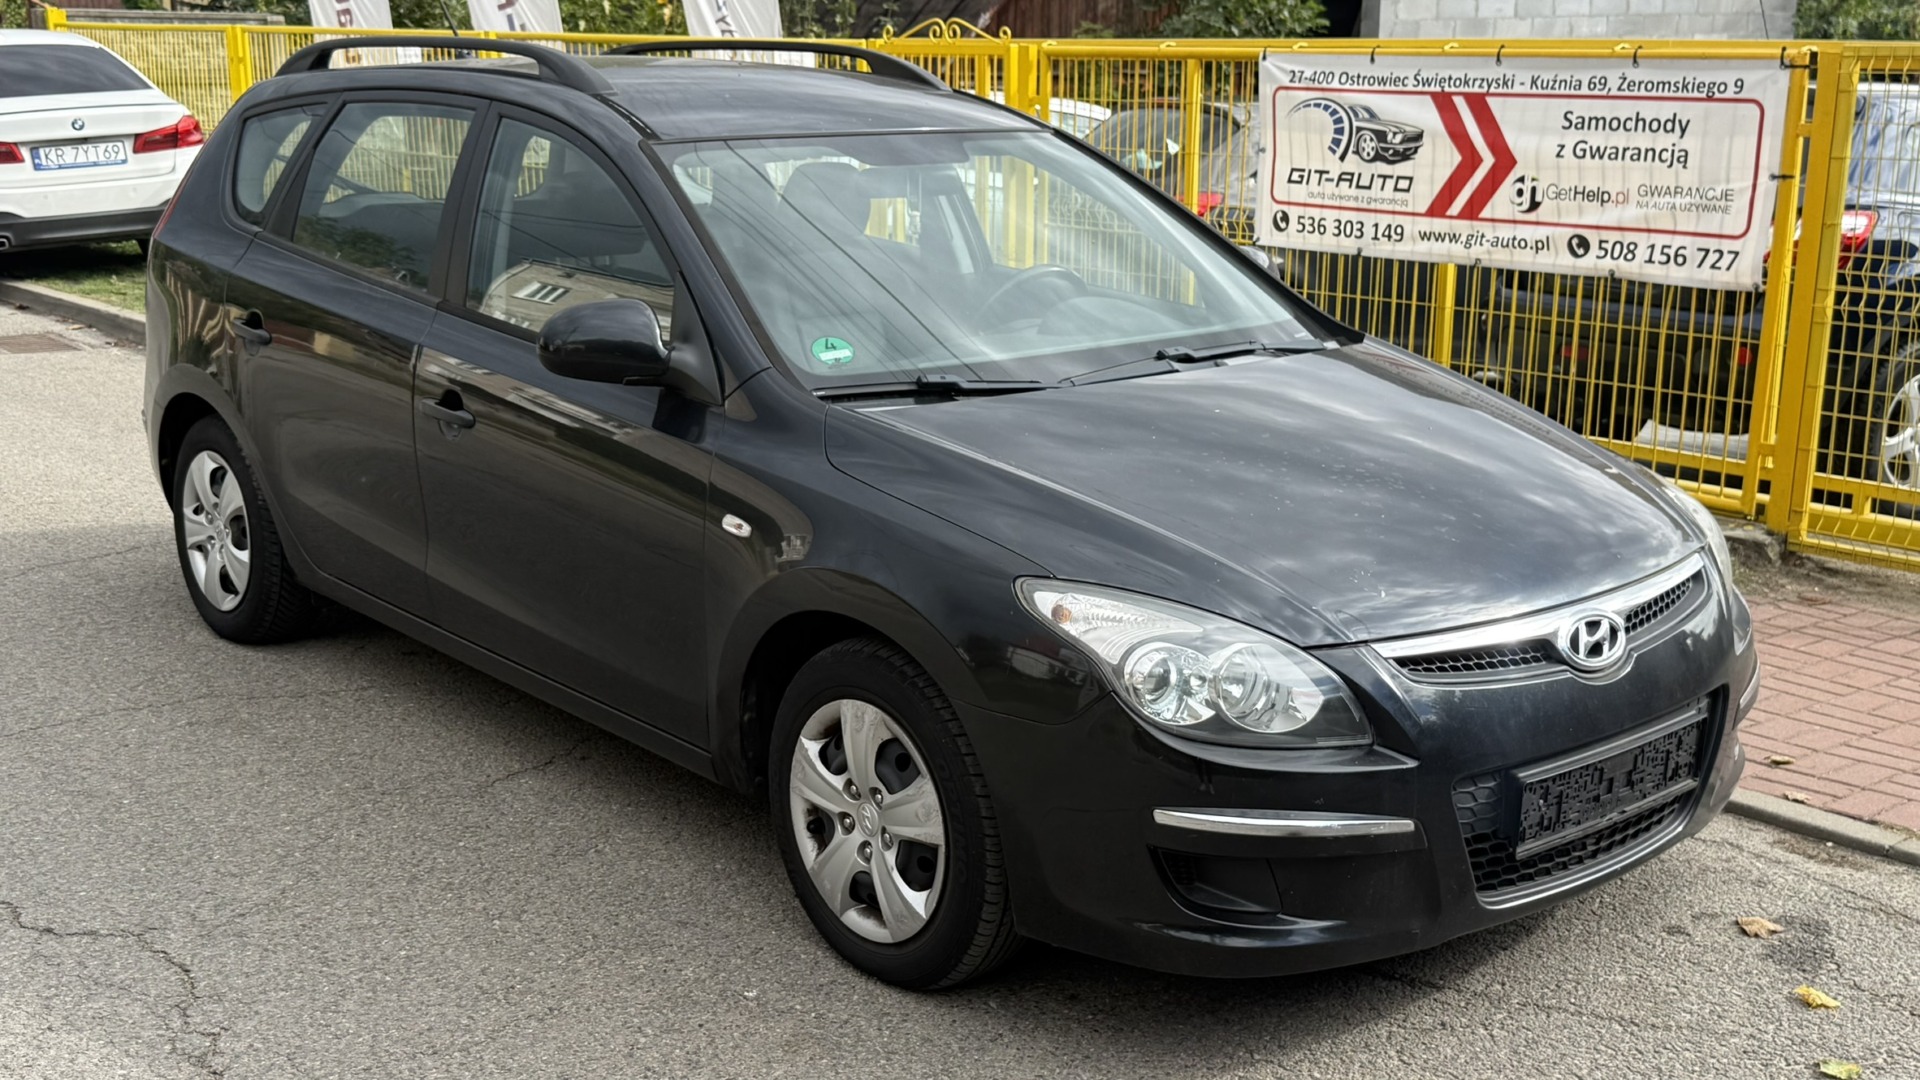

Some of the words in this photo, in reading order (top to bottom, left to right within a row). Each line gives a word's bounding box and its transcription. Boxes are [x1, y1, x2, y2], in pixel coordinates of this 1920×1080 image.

[1288, 70, 1335, 85] 27-400
[1338, 71, 1409, 88] Ostrowiec
[1412, 68, 1515, 93] Świętokrzyski
[1530, 74, 1582, 91] Kuźnia
[1587, 75, 1612, 95] 69,
[1616, 72, 1728, 98] Żeromskiego
[1733, 77, 1744, 95] 9
[1561, 110, 1691, 139] Samochody
[43, 147, 66, 165] KR
[71, 144, 121, 163] 7YT69
[1555, 143, 1566, 158] z
[1572, 139, 1689, 169] Gwarancją
[1286, 167, 1414, 193] GIT-AUTO
[1637, 183, 1735, 202] GWARANCJE
[1307, 191, 1325, 200] auta
[1327, 191, 1359, 203] używane
[1366, 196, 1409, 208] gwarancją
[1545, 182, 1630, 208] GetHelp.pl
[1635, 200, 1649, 210] NA
[1650, 201, 1677, 212] AUTA
[1296, 215, 1327, 236] 536
[1332, 218, 1364, 239] 303
[1371, 222, 1405, 243] 149
[1418, 229, 1550, 254] www.git-auto.pl
[1595, 238, 1638, 262] 508
[1643, 243, 1688, 267] 156
[1696, 248, 1740, 272] 727
